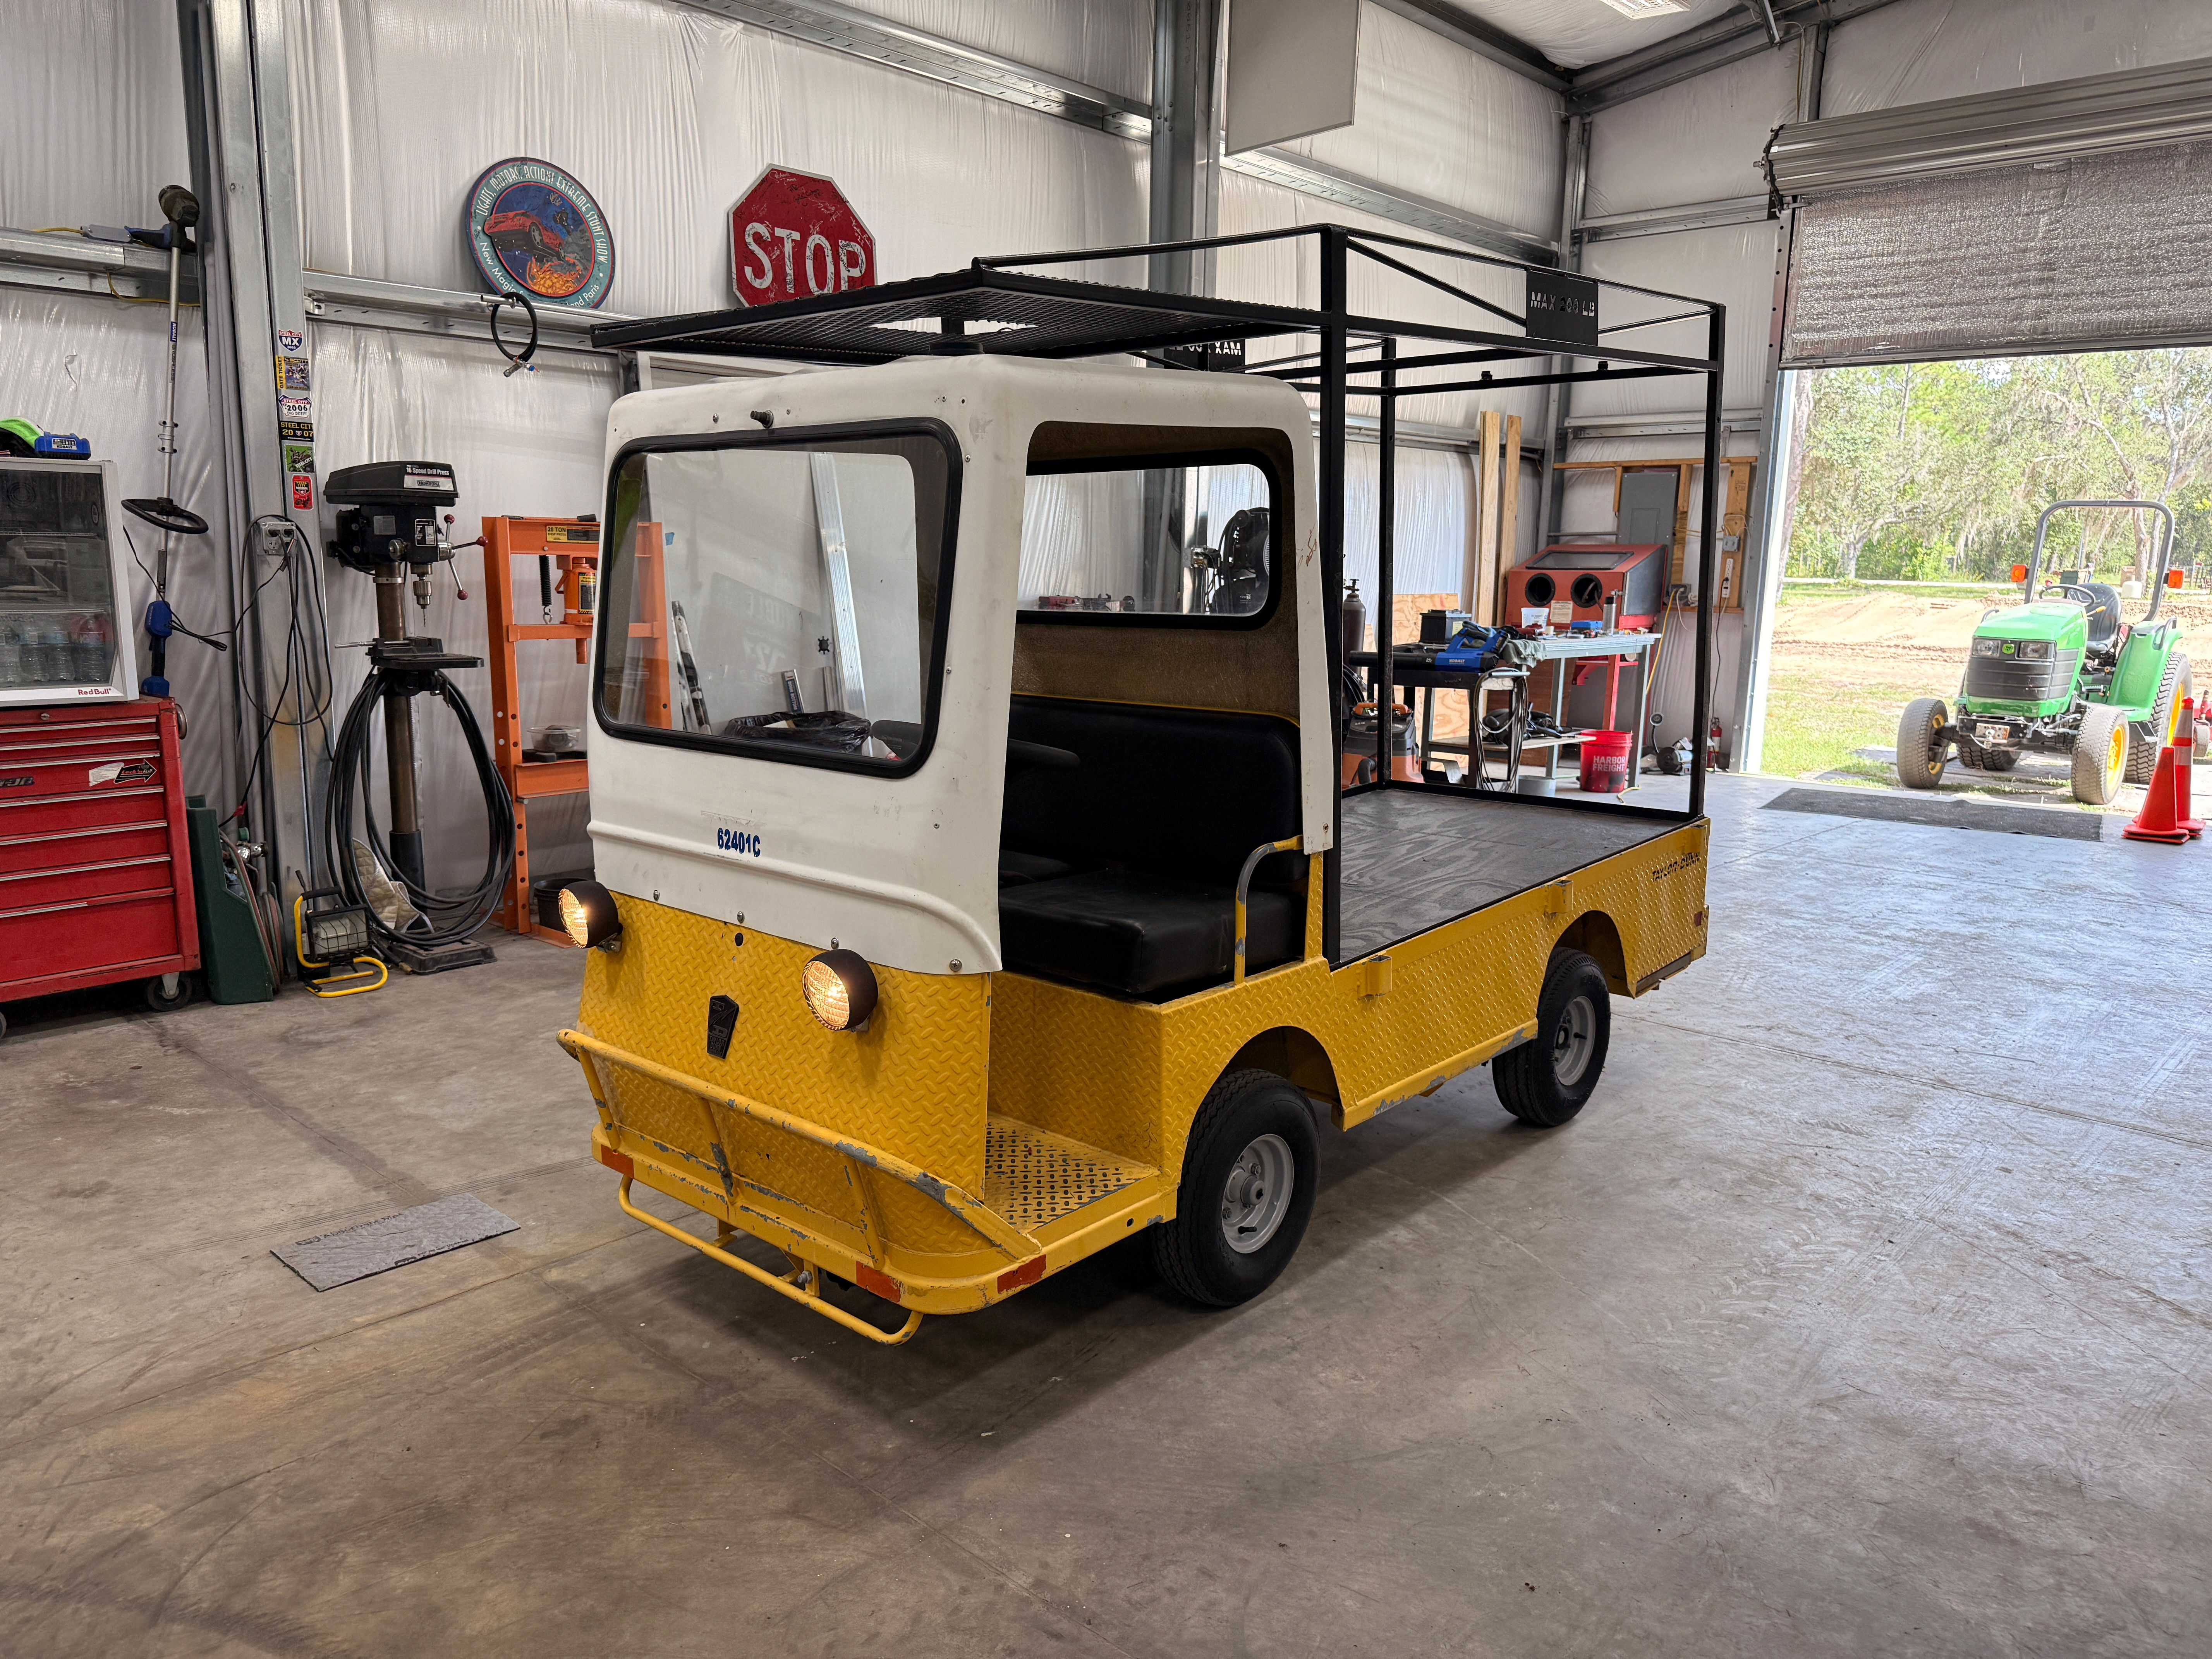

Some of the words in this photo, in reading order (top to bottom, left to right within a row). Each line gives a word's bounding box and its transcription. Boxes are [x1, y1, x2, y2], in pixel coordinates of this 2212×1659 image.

[524, 166, 554, 184] ACTION!
[556, 176, 591, 212] EXTREME
[586, 211, 605, 235] STUNT
[596, 239, 608, 263] SHOW
[479, 242, 494, 264] New
[744, 222, 866, 295] STOP
[583, 285, 599, 301] Paris
[1531, 292, 1556, 310] MAX
[1559, 296, 1579, 314] 200
[1582, 301, 1595, 317] LB
[282, 337, 299, 346] MX
[1593, 755, 1626, 764] HARBOR
[1593, 763, 1625, 772] FREIGHT
[717, 827, 761, 857] 62401C
[709, 1035, 725, 1048] TAYLOR
